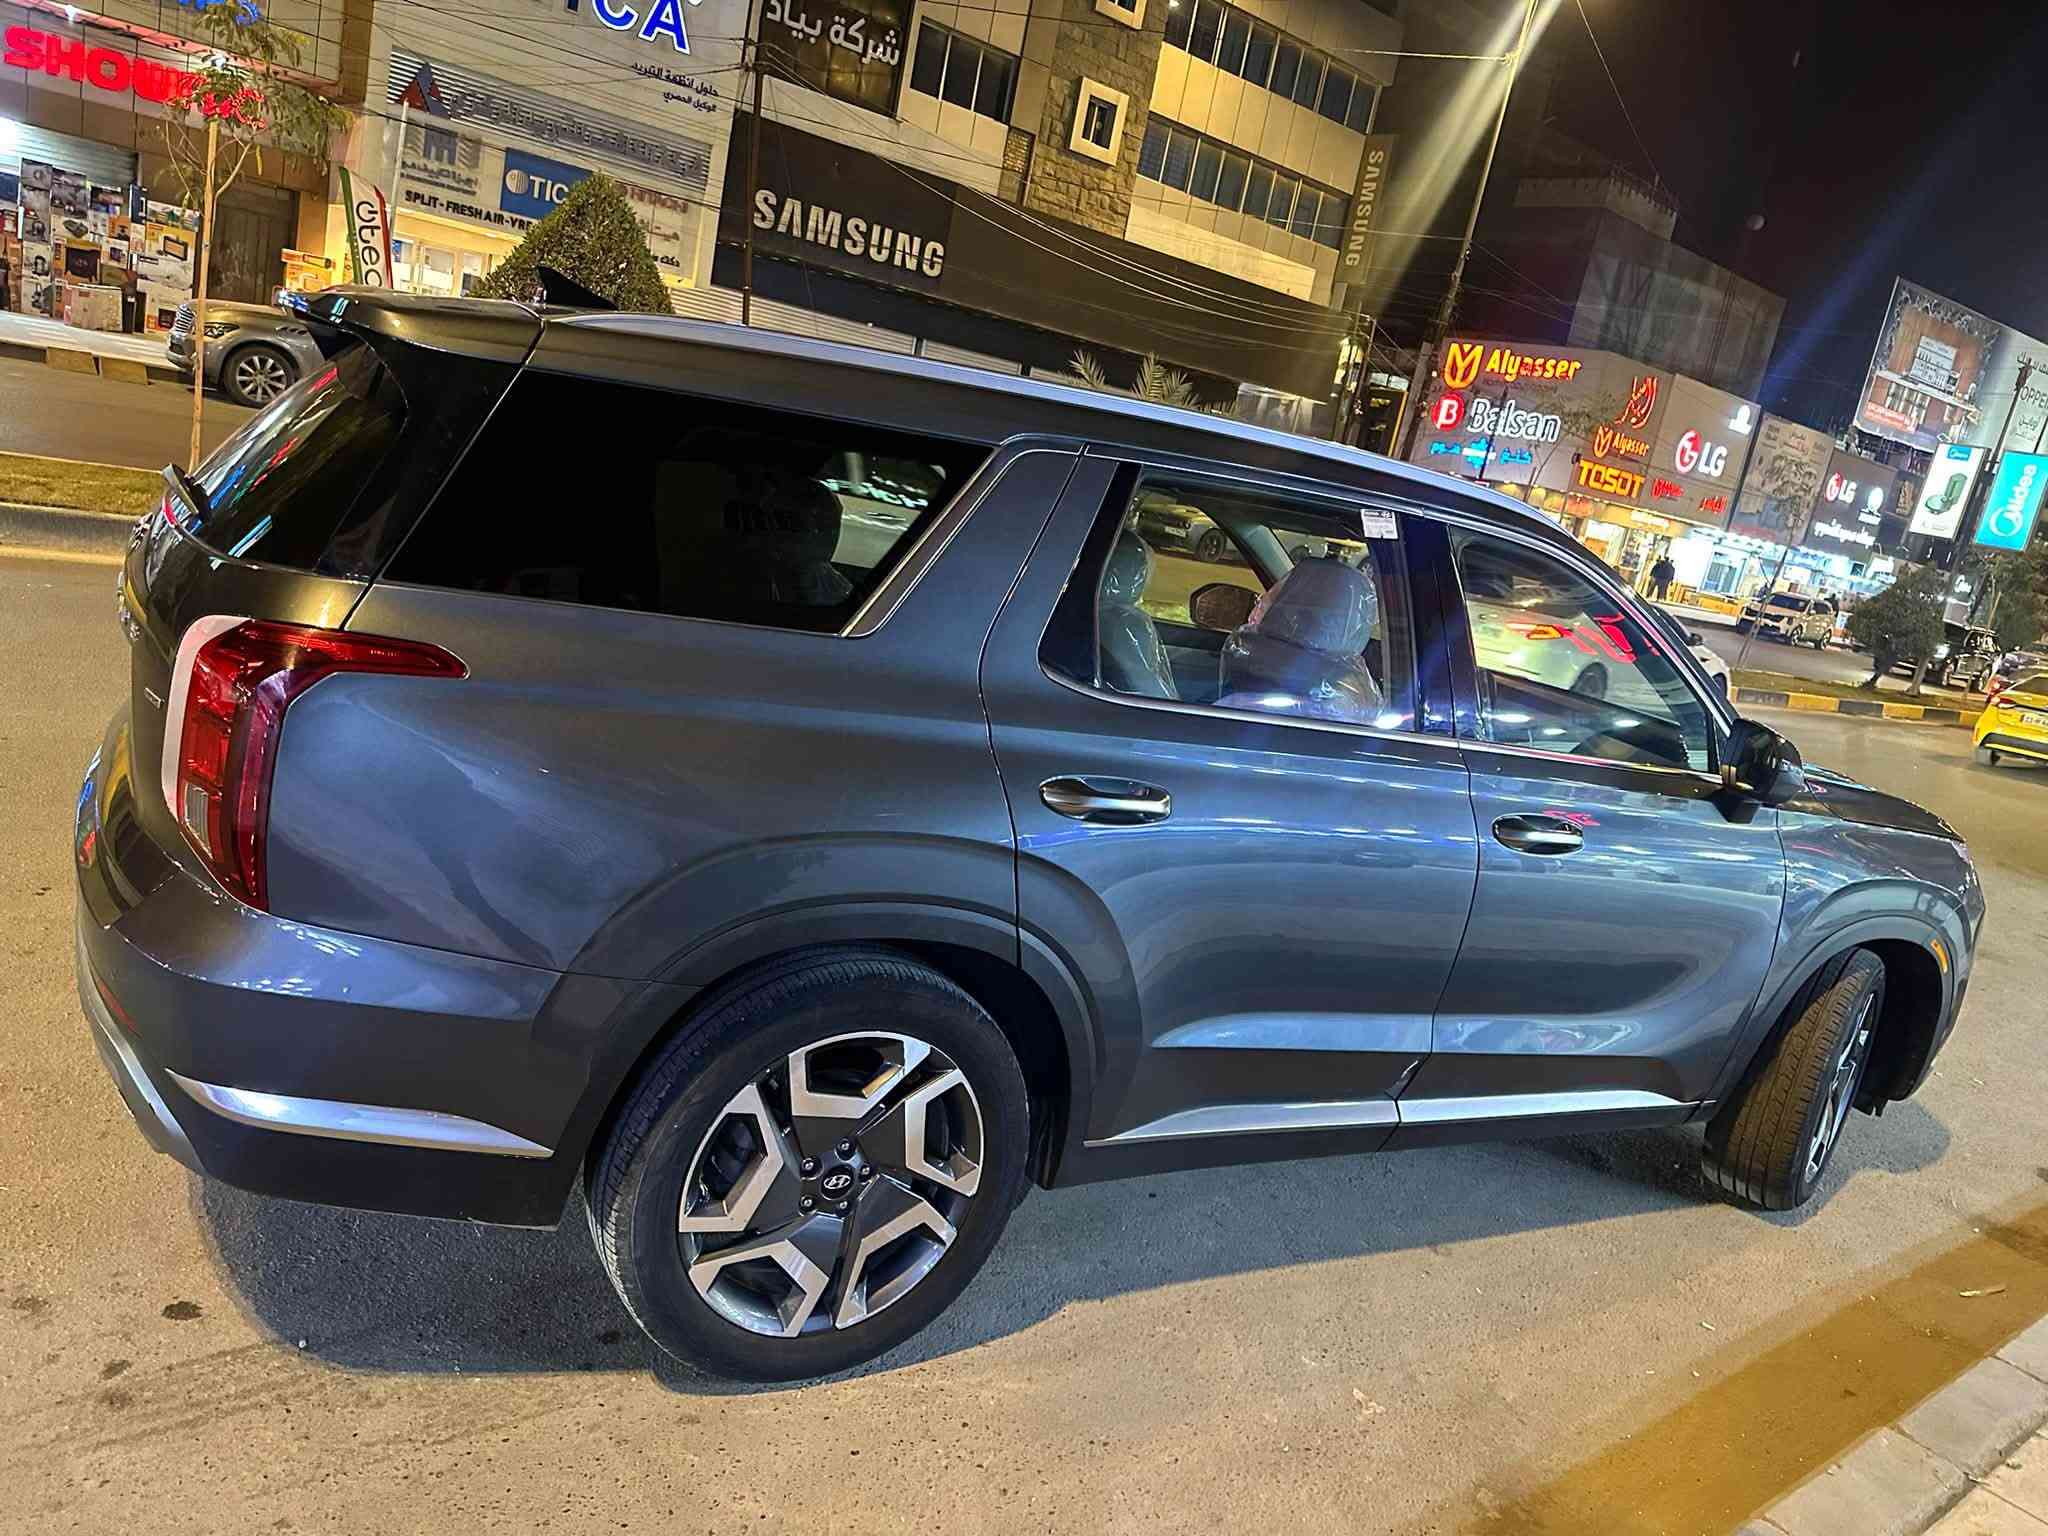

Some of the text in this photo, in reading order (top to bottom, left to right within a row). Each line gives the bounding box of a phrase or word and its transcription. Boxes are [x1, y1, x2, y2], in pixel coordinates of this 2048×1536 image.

[829, 15, 900, 66] شركة
[529, 174, 569, 206] TIC
[1345, 149, 1384, 268] SAMSUNG
[753, 189, 945, 278] SAMSUNG
[1485, 349, 1582, 383] Alyasser
[1466, 397, 1561, 443] Balsan
[1578, 458, 1646, 499] TOSOT
[1697, 441, 1728, 478] LG
[1839, 478, 1857, 504] LG
